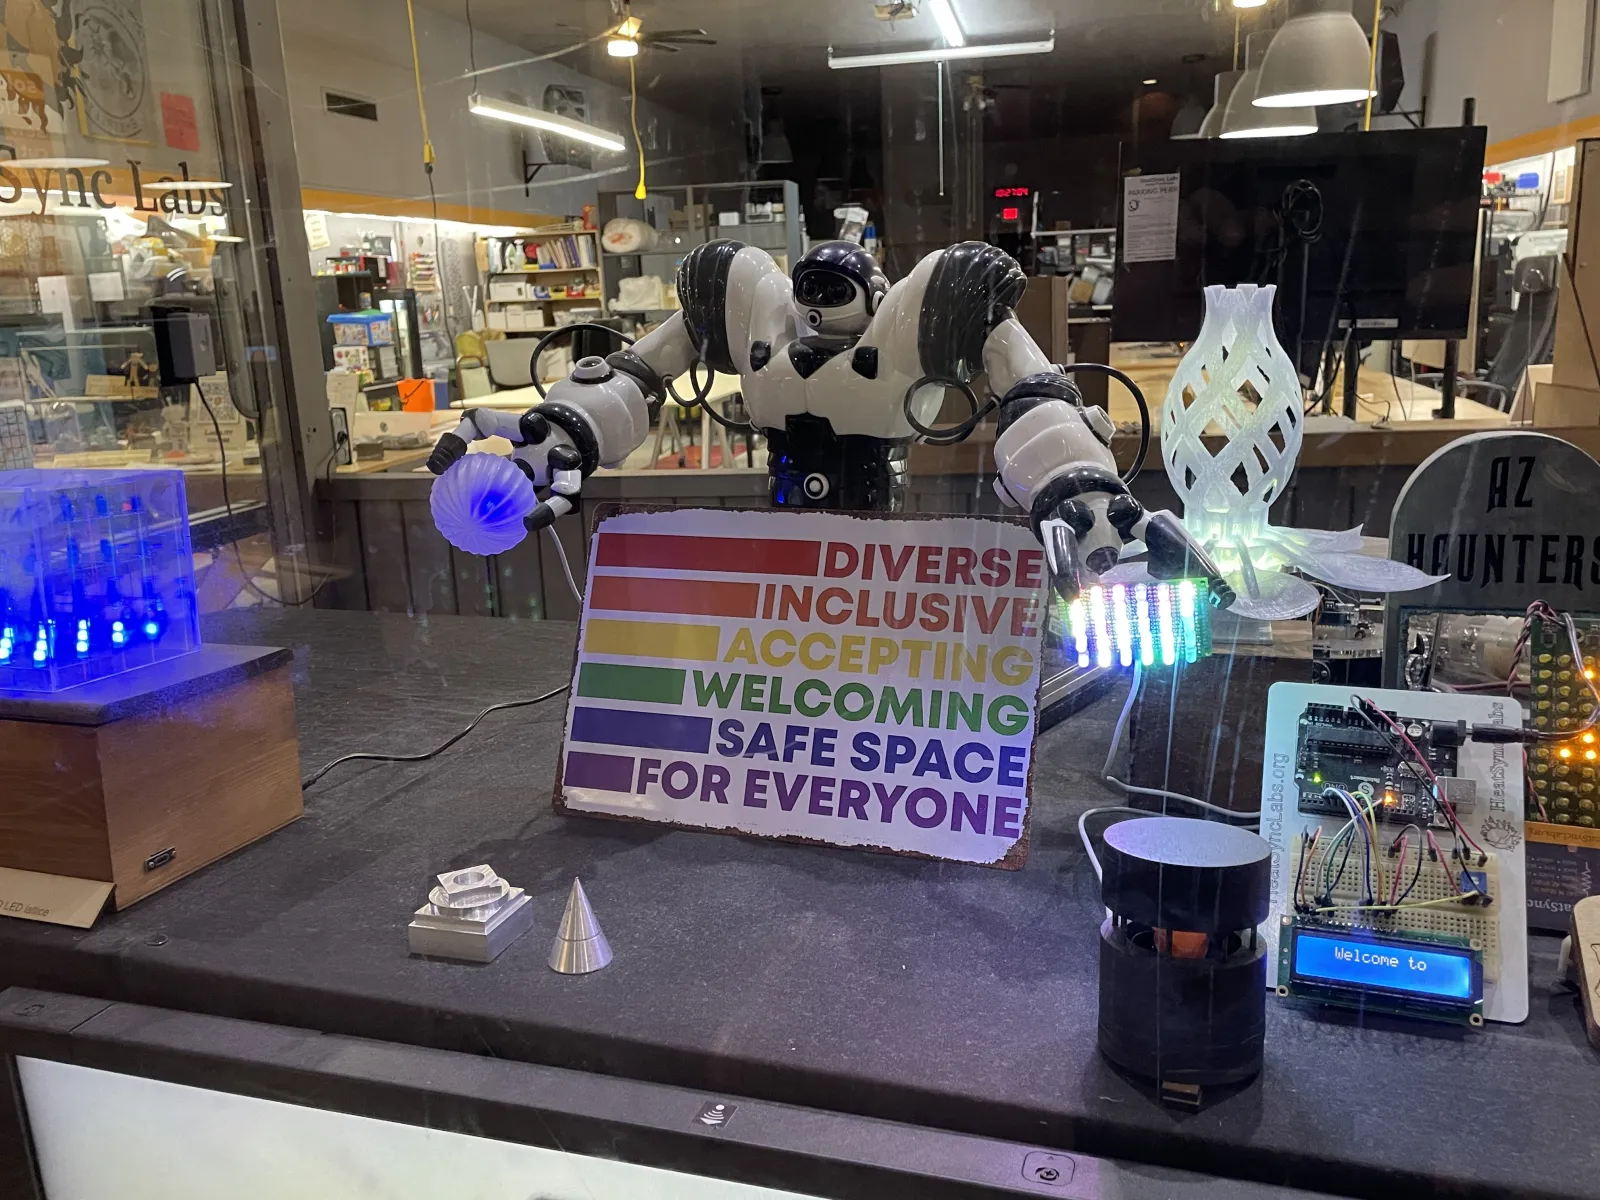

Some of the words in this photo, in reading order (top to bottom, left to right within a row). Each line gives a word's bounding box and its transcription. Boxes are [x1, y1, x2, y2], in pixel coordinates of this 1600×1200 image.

[0, 144, 117, 217] Sync
[126, 159, 227, 217] Labs
[1486, 456, 1536, 513] AZ
[824, 541, 1043, 588] DIVERSE
[762, 583, 1040, 637] INCLUSIVE
[722, 627, 1034, 686] ACCEPTING
[692, 669, 1030, 736] WELCOMING
[716, 718, 839, 767] SAFE
[850, 731, 1027, 788] SPACE
[636, 757, 731, 804] FOR
[743, 768, 1022, 839] EVERYONE
[4, 901, 23, 912] LED
[1334, 946, 1399, 967] Welcome
[1408, 956, 1427, 971] to
